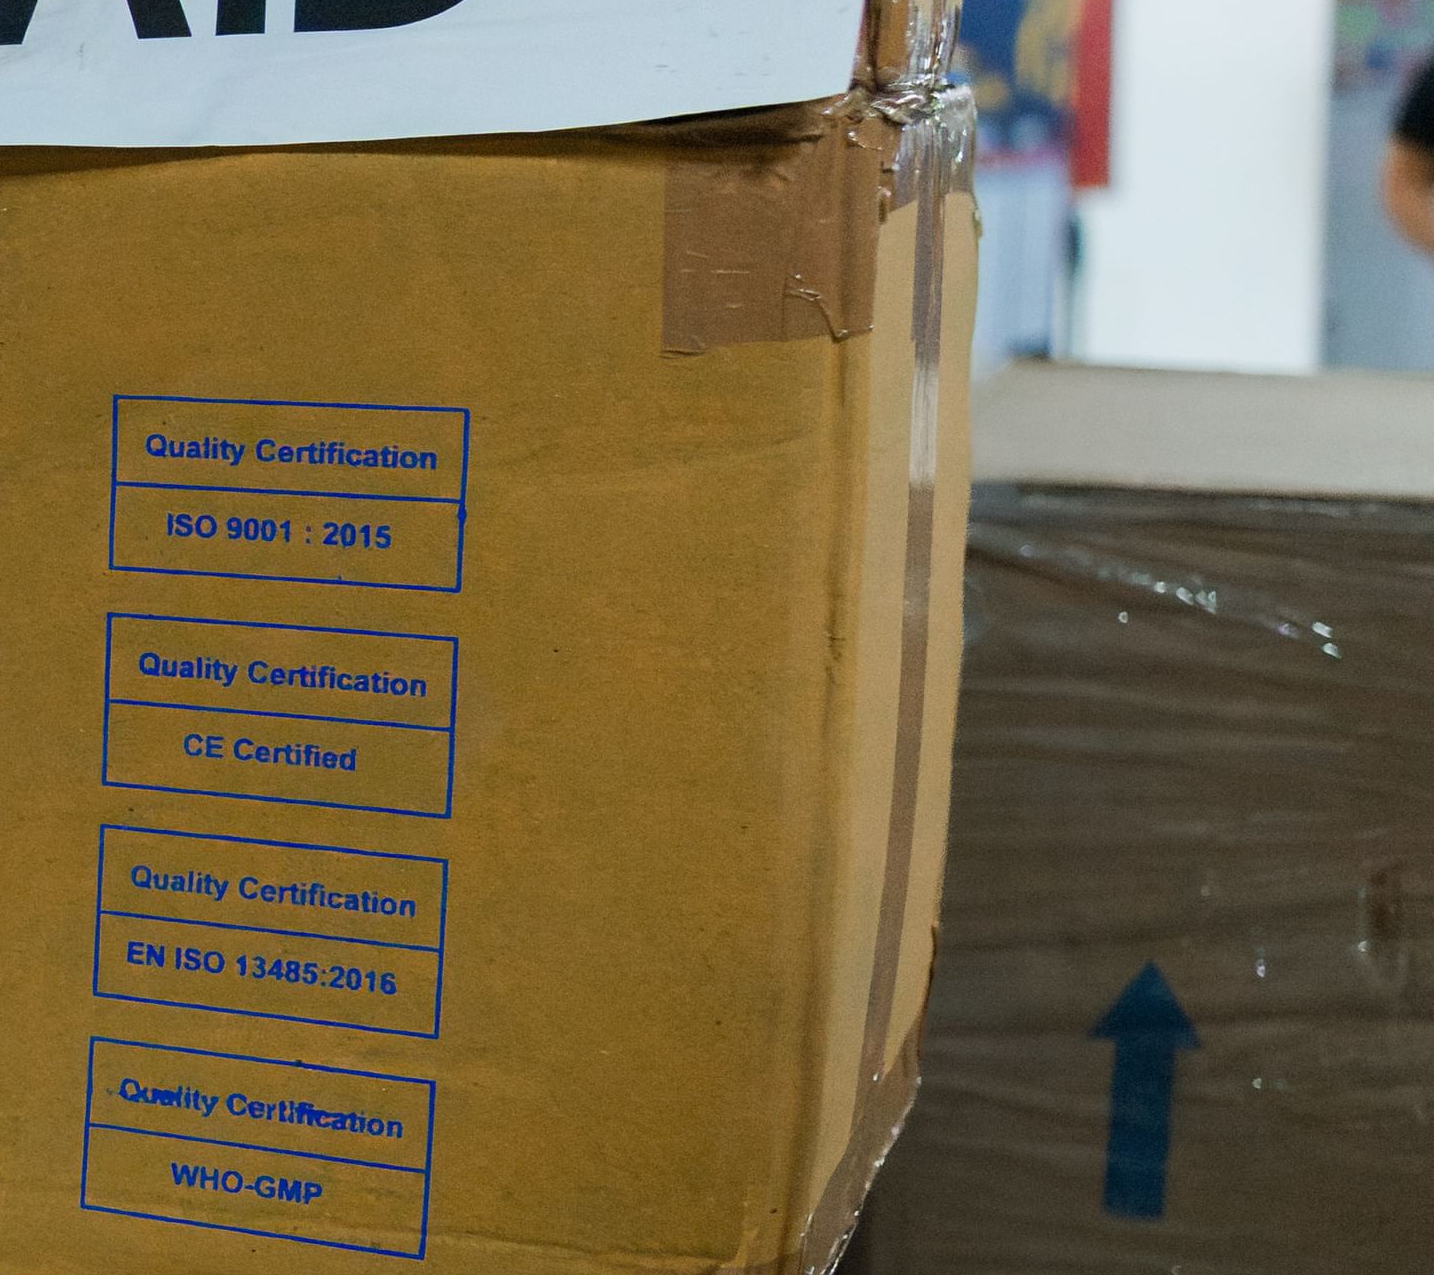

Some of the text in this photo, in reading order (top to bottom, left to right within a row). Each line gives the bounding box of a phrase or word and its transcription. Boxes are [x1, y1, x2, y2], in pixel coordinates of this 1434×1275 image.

[145, 433, 437, 469] Quality Certification
[167, 512, 217, 538] ISO
[227, 516, 291, 543] 9001
[323, 522, 392, 549] 2015
[139, 652, 427, 698] Quality Certification
[183, 733, 357, 772] CE Certified
[131, 865, 416, 918] Quality Certification
[126, 941, 398, 995] EN ISO 13485:2016
[118, 1077, 404, 1139] Quality Certification
[171, 1163, 323, 1205] WHO-GMP
